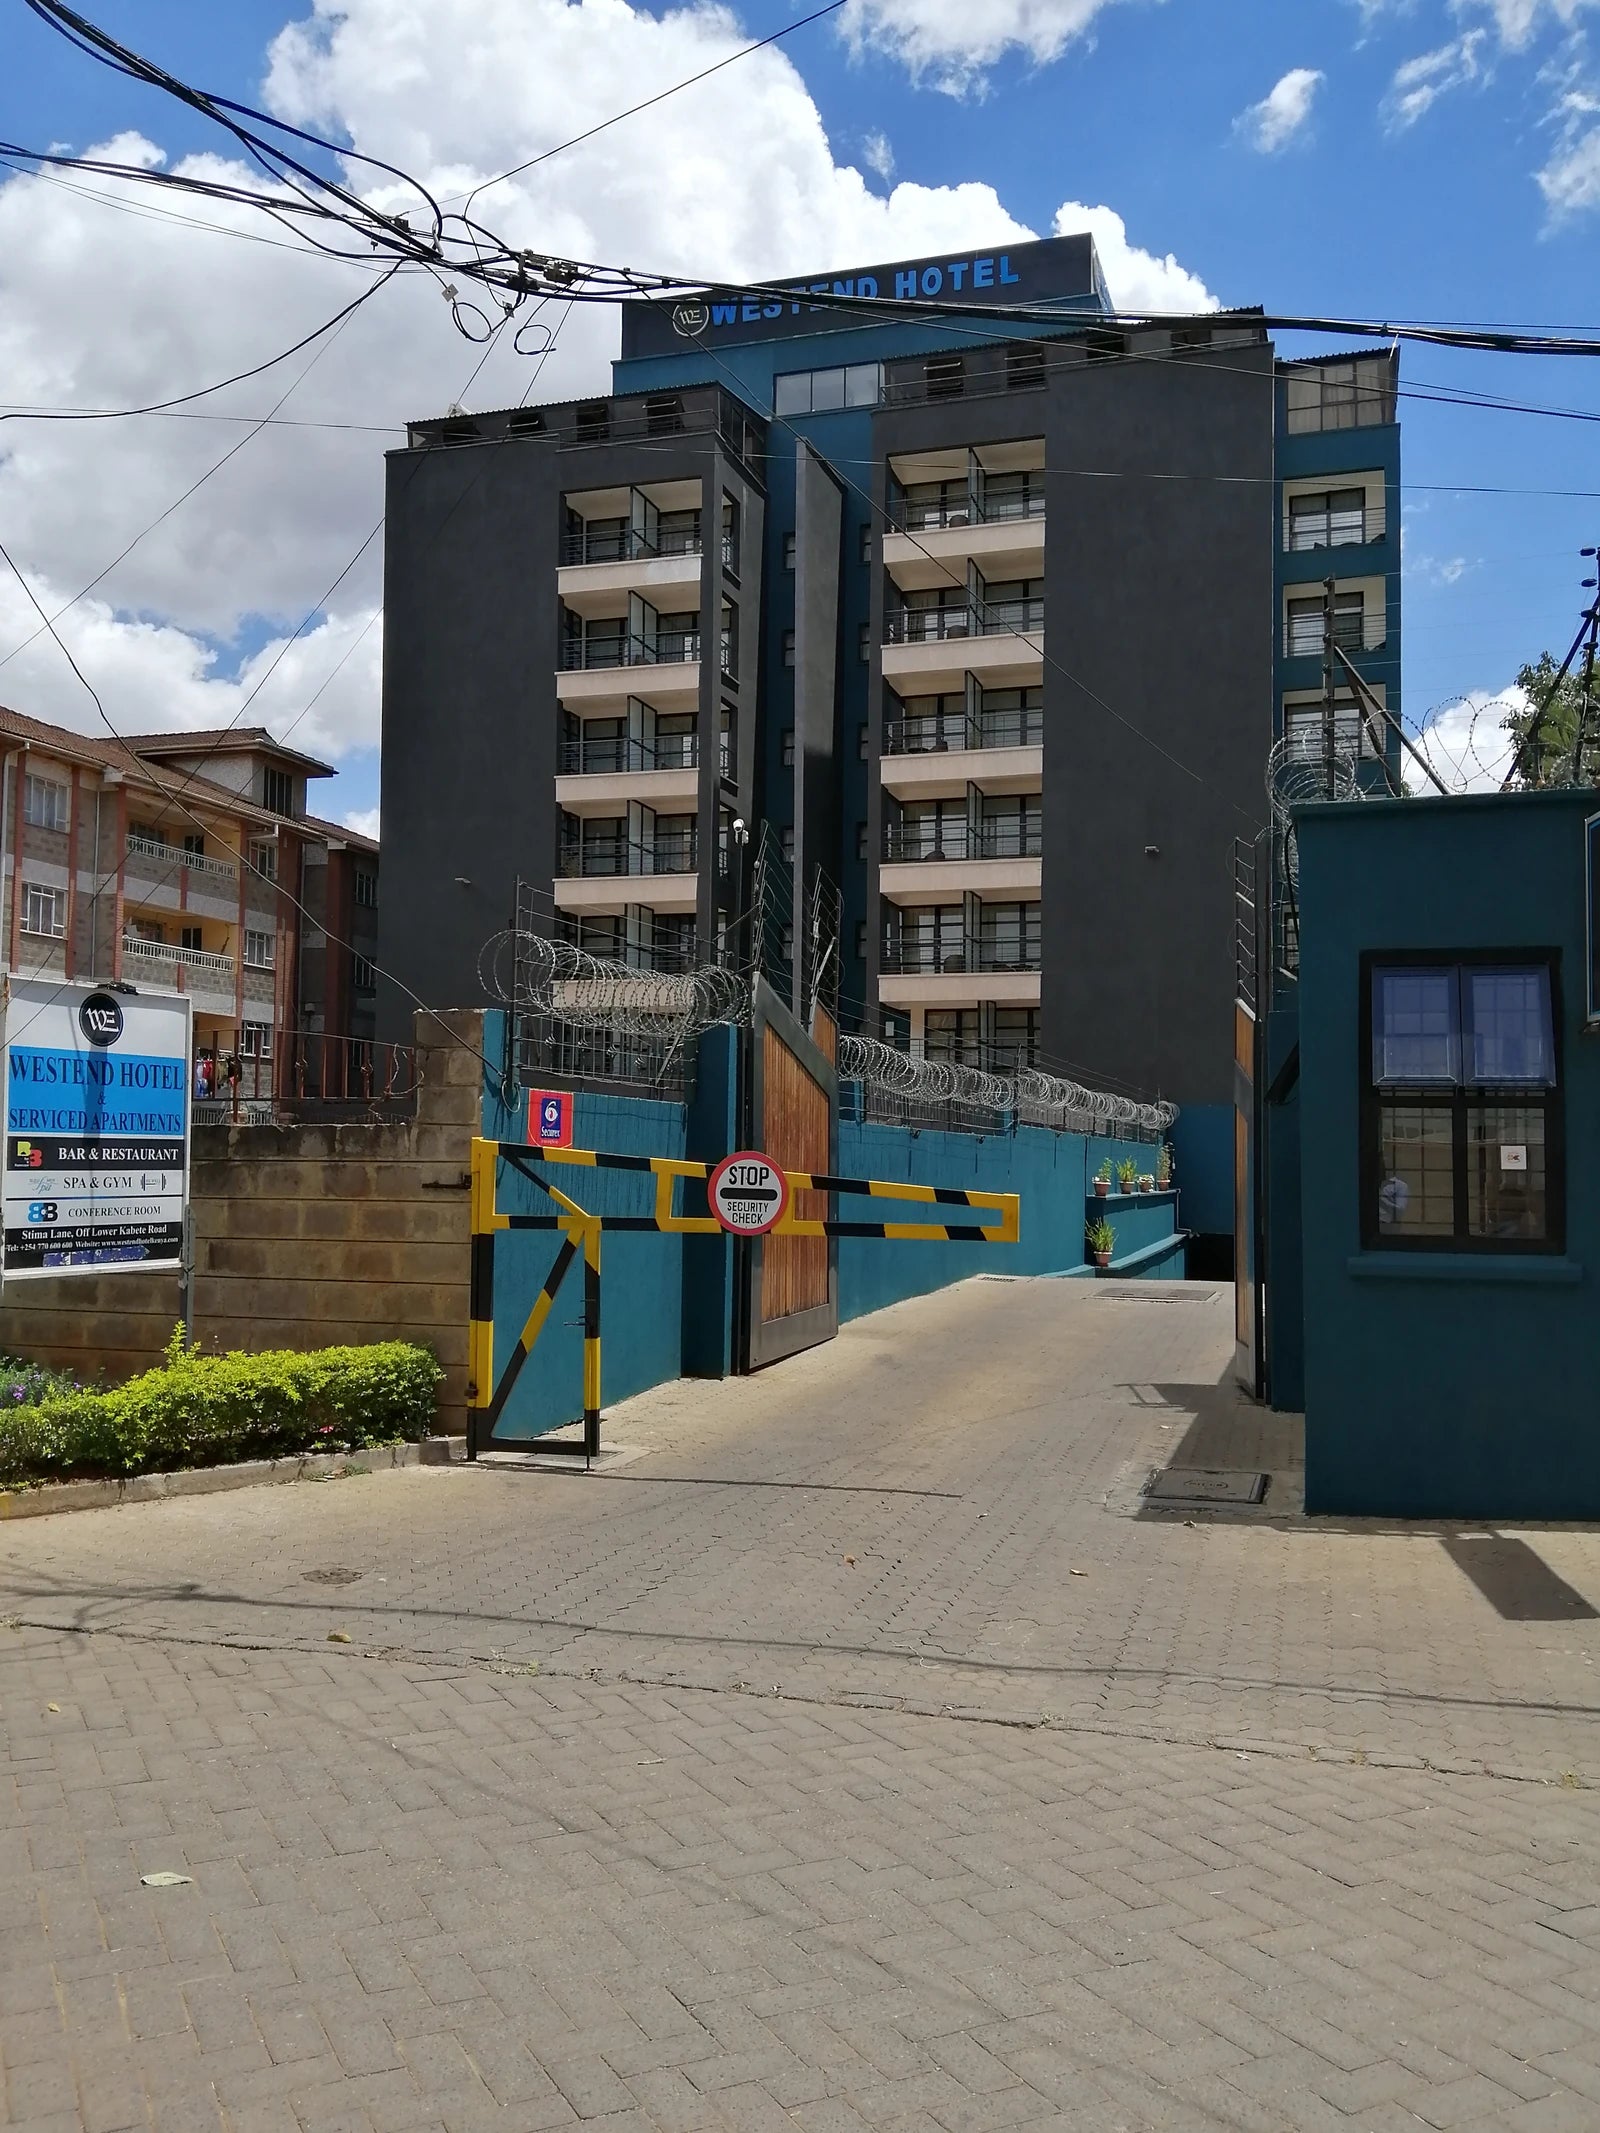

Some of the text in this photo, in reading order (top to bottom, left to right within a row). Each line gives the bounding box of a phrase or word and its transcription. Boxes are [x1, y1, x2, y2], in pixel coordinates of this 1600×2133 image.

[895, 256, 1020, 300] HOTEL
[9, 1055, 183, 1091] WESTEND HOTEL
[97, 1091, 106, 1105] &
[9, 1108, 181, 1132] SERVICED APARTMENTS
[58, 1147, 179, 1160] BAR & RESTAURANT
[63, 1177, 86, 1189] SPA
[90, 1176, 99, 1189] &
[103, 1176, 132, 1189] GYM
[729, 1166, 770, 1186] STOP
[68, 1206, 161, 1218] CONFERENCE ROOM
[727, 1201, 769, 1212] SECURITY
[732, 1213, 763, 1224] CHECK
[22, 1224, 167, 1240] Stima Lane, Off Lower Kabete Road
